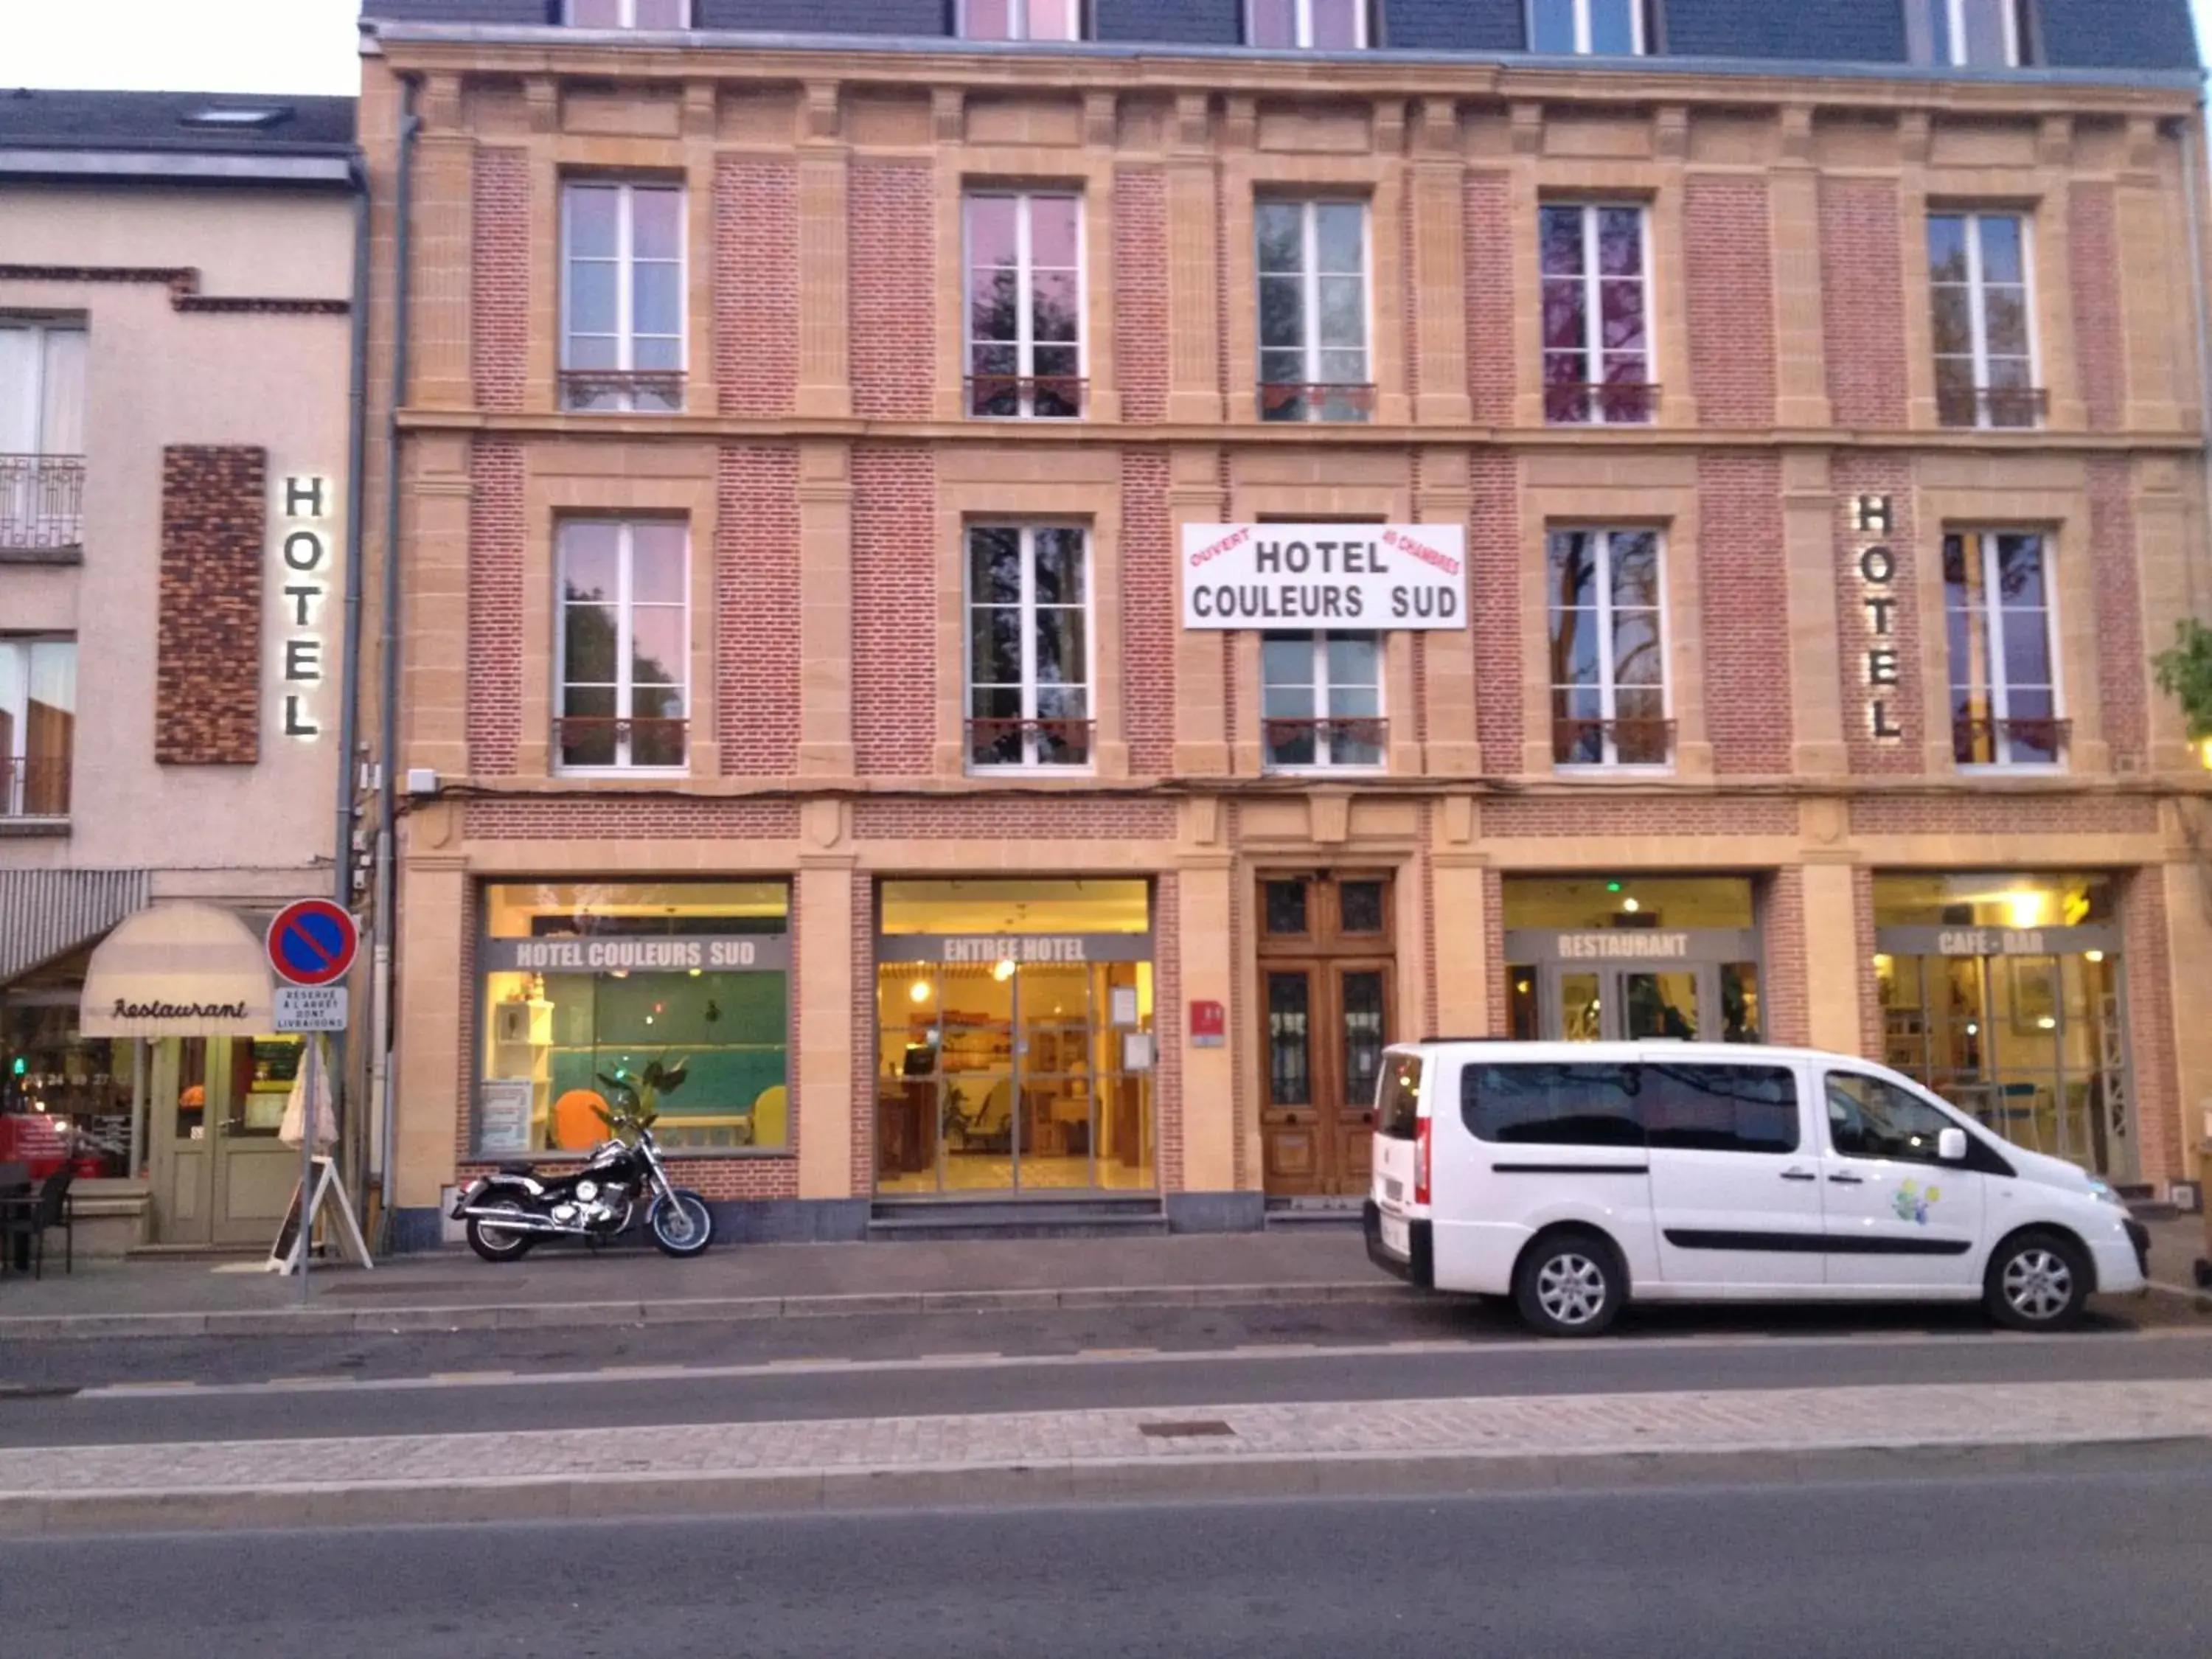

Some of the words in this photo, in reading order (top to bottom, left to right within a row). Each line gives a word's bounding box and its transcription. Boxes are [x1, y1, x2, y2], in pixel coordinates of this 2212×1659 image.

[1189, 526, 1250, 568] OUVERT
[1256, 540, 1390, 574] HOTEL
[284, 477, 323, 736] HOTEL
[1193, 585, 1364, 618] COULEURS
[1391, 587, 1457, 619] SUD
[1858, 493, 1901, 738] HOTEL
[517, 942, 583, 967] HOTEL
[588, 942, 701, 967] COULEURS
[710, 941, 755, 965] SUD
[1023, 938, 1086, 961] HOTEL
[1558, 933, 1688, 958] RESTAURANT
[112, 998, 248, 1020] Restaurant
